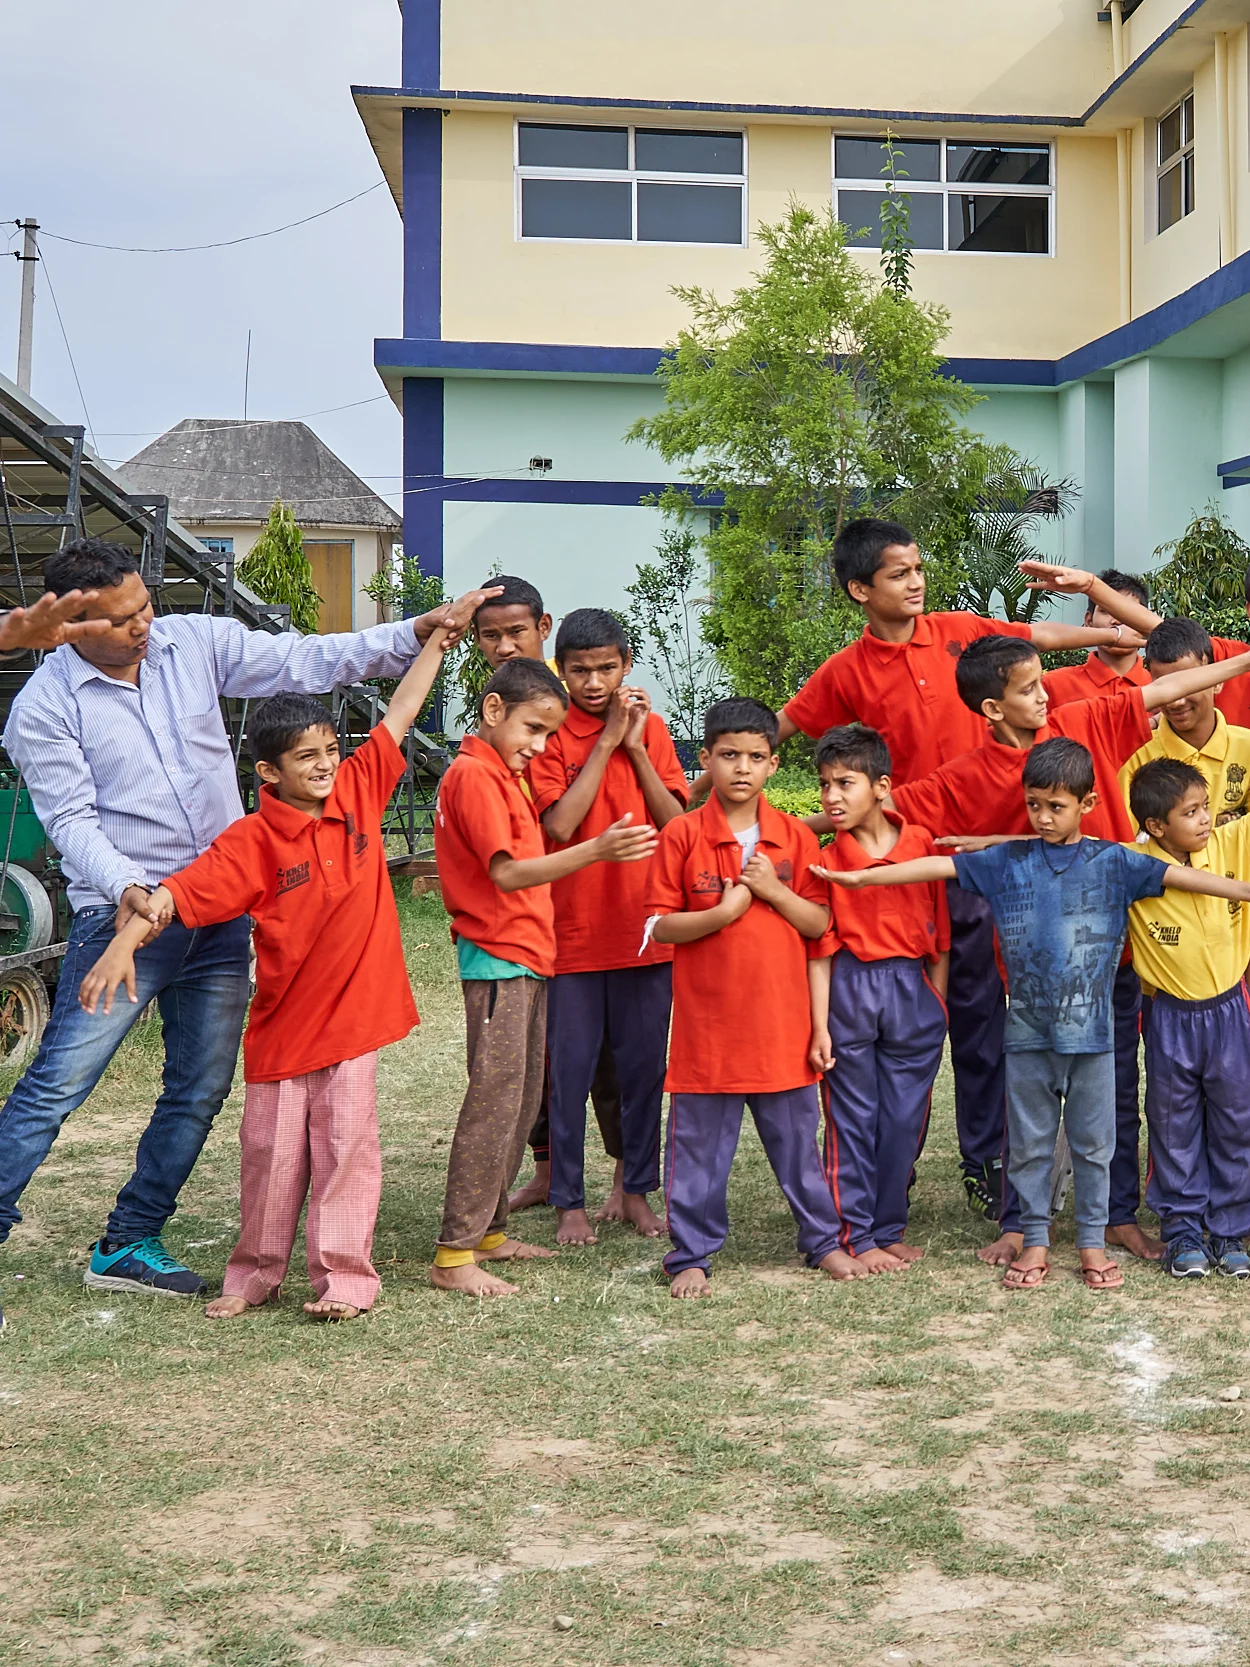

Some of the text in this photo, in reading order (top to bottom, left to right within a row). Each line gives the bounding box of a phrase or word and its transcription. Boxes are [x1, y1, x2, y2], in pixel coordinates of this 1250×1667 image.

[286, 861, 309, 877] KHELO
[286, 870, 309, 886] INDIA
[1160, 926, 1181, 934] KHELO
[1158, 934, 1179, 942] INDIA
